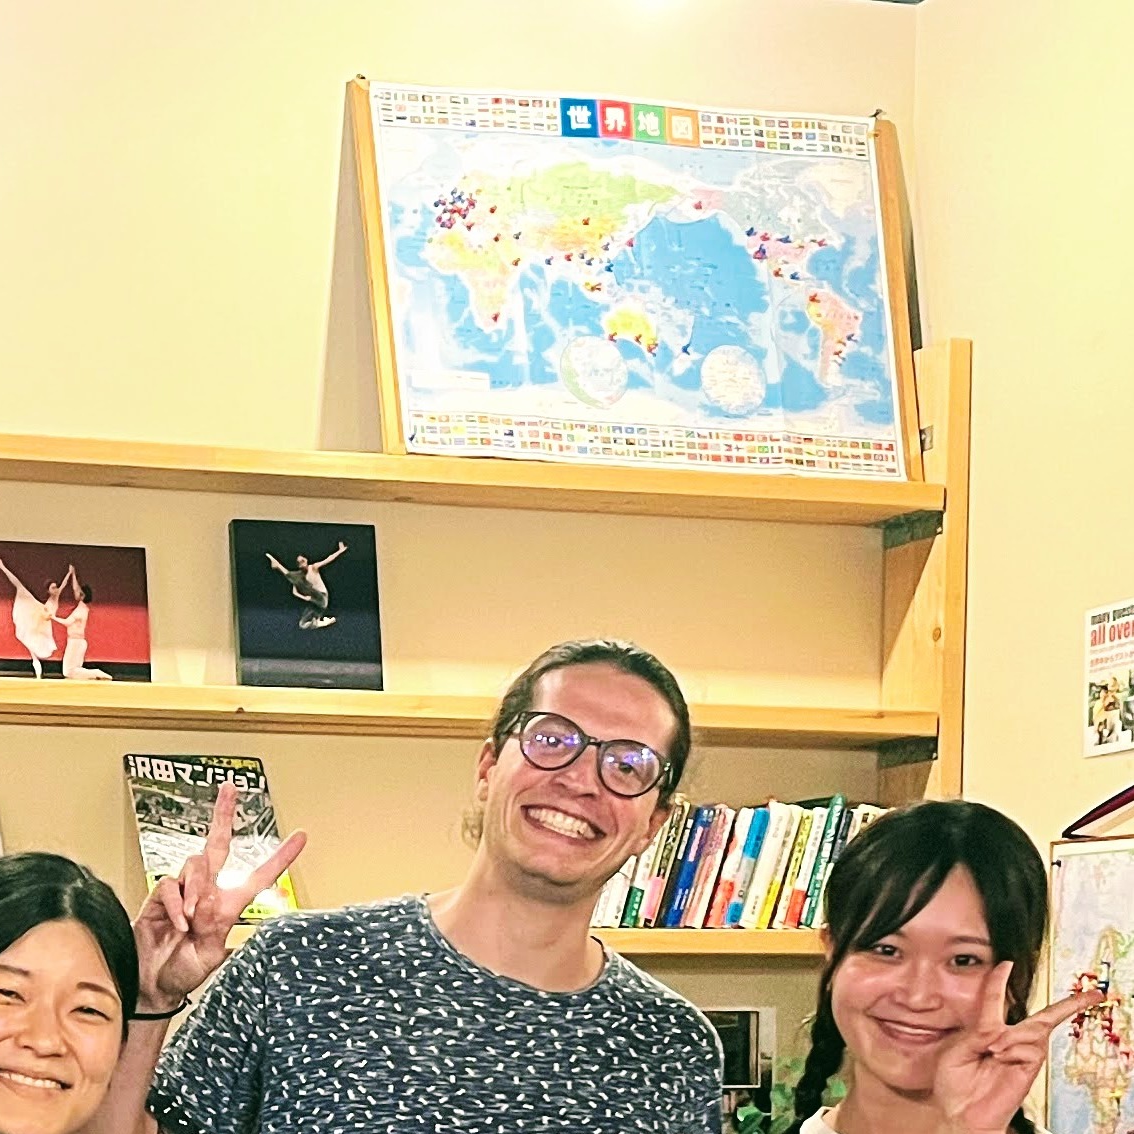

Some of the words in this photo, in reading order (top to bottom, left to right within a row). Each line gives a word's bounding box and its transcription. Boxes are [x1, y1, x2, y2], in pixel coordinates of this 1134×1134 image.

[566, 104, 693, 141] 世界地図
[1090, 623, 1106, 647] all
[127, 755, 266, 794] 沢田マンション
